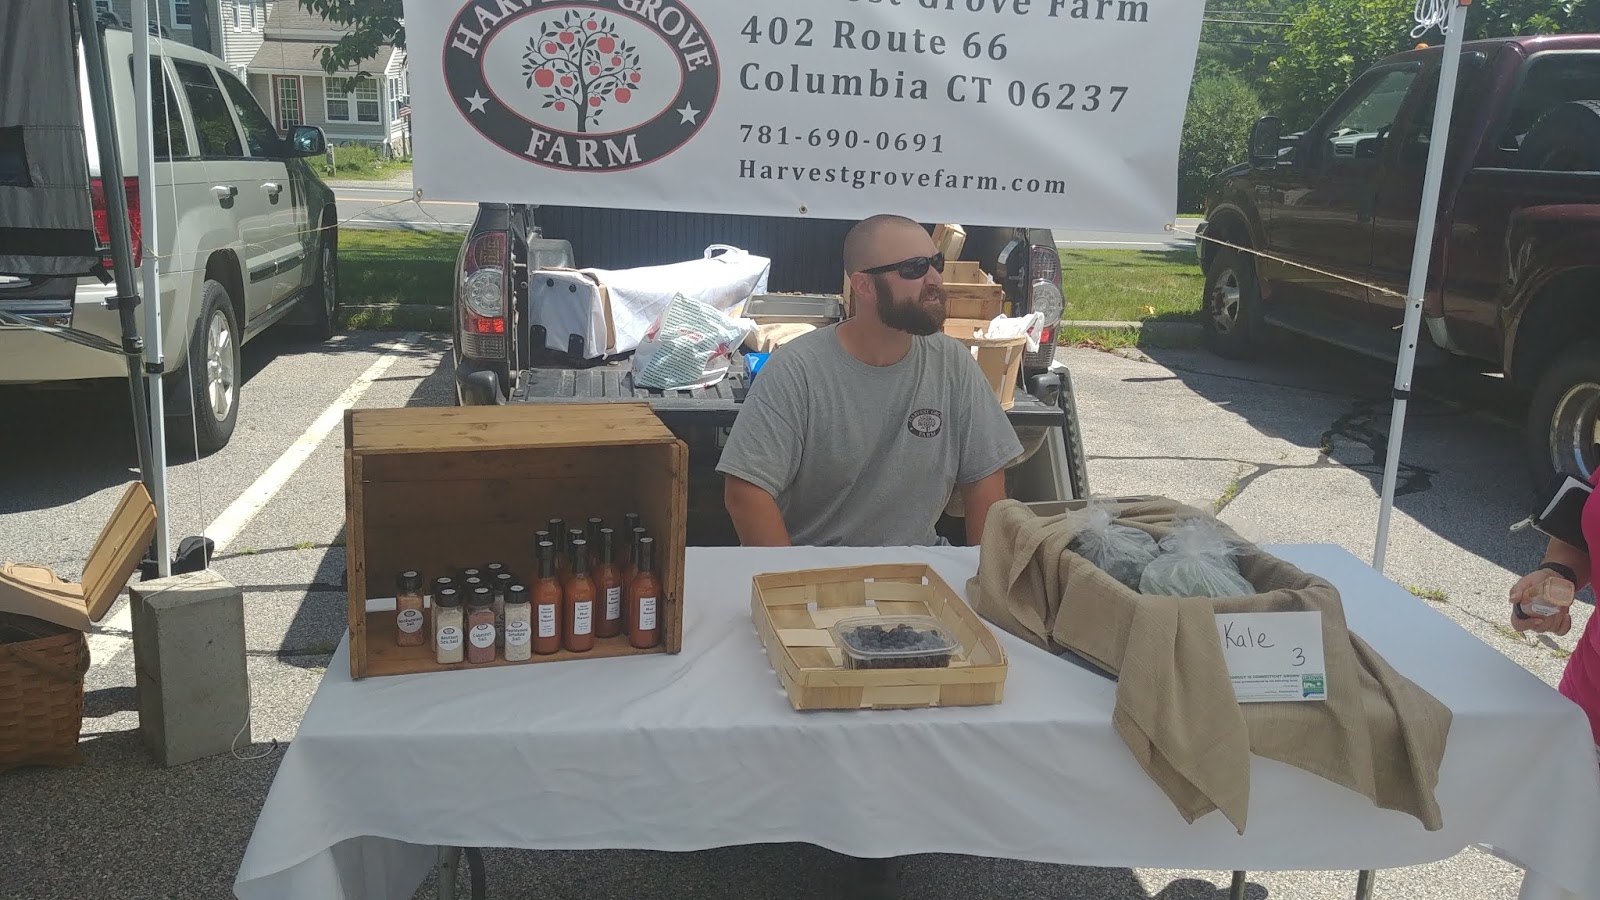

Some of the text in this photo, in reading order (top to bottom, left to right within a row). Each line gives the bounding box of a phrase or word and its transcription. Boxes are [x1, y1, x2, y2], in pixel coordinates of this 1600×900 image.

[740, 15, 1008, 60] 402 Route 66
[739, 62, 1129, 113] Columbia CT 06237
[524, 128, 643, 169] FARM
[739, 124, 944, 154] 781-690-0691
[738, 159, 1066, 194] Harvestgrovefarm.com
[1223, 621, 1275, 649] Kale
[1291, 647, 1306, 667] 3
